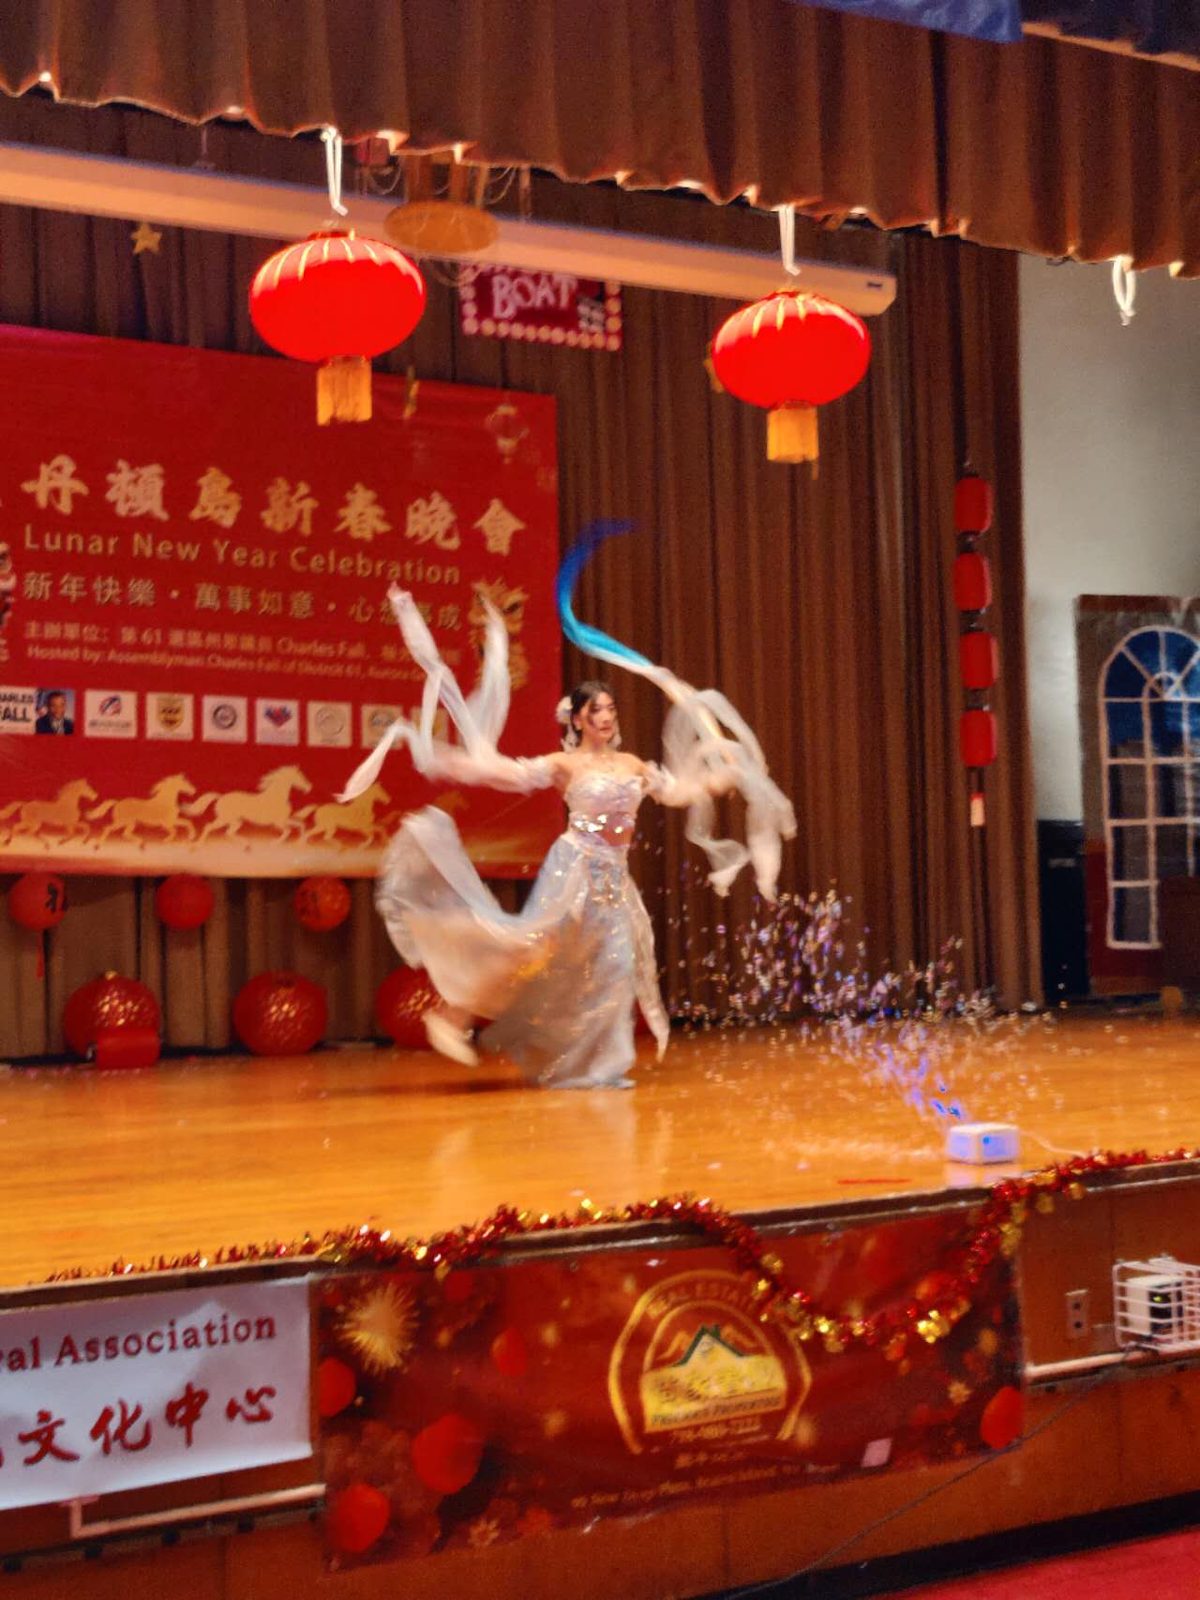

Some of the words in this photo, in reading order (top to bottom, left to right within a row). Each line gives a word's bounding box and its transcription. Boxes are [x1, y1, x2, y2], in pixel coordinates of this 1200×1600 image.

[491, 271, 578, 319] BOAT
[25, 523, 119, 555] Lunar
[132, 532, 200, 562] New
[213, 538, 277, 569] Year
[290, 546, 460, 584] Celebration
[0, 706, 32, 723] ALL
[0, 1337, 41, 1373] al
[54, 1313, 277, 1366] Association
[0, 1382, 277, 1467] 文化中心
